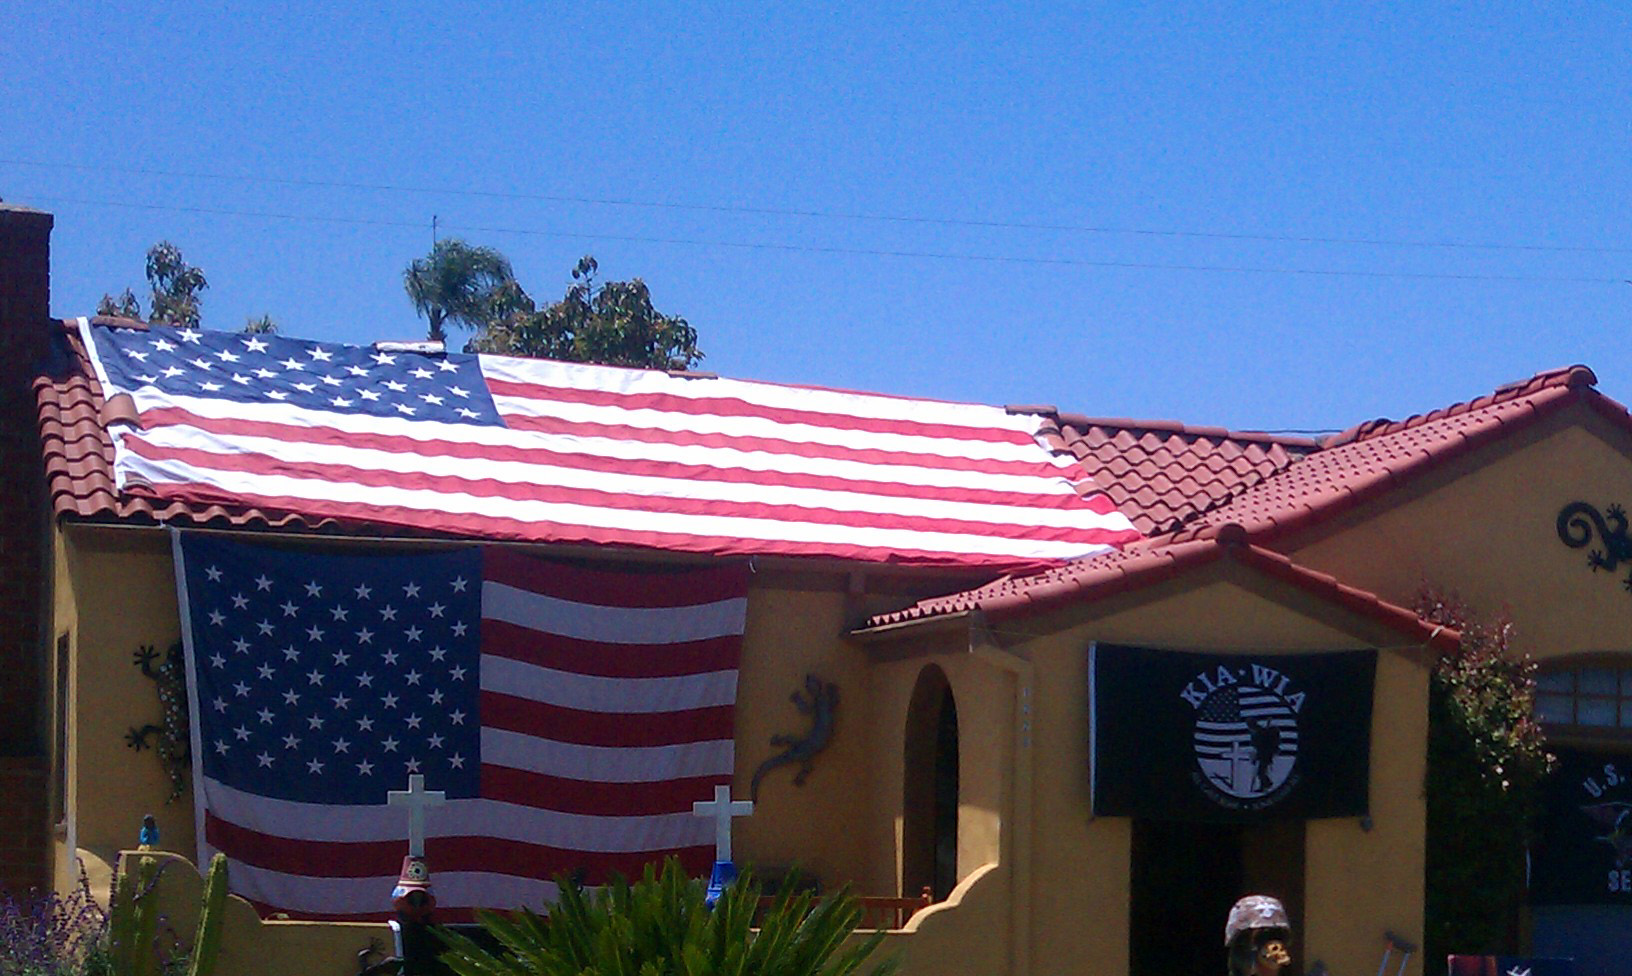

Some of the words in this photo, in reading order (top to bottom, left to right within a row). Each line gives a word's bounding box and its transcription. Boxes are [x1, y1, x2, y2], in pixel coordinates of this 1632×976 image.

[1180, 664, 1238, 710] KIA
[1251, 663, 1306, 713] WIA
[1583, 763, 1625, 798] U.S.
